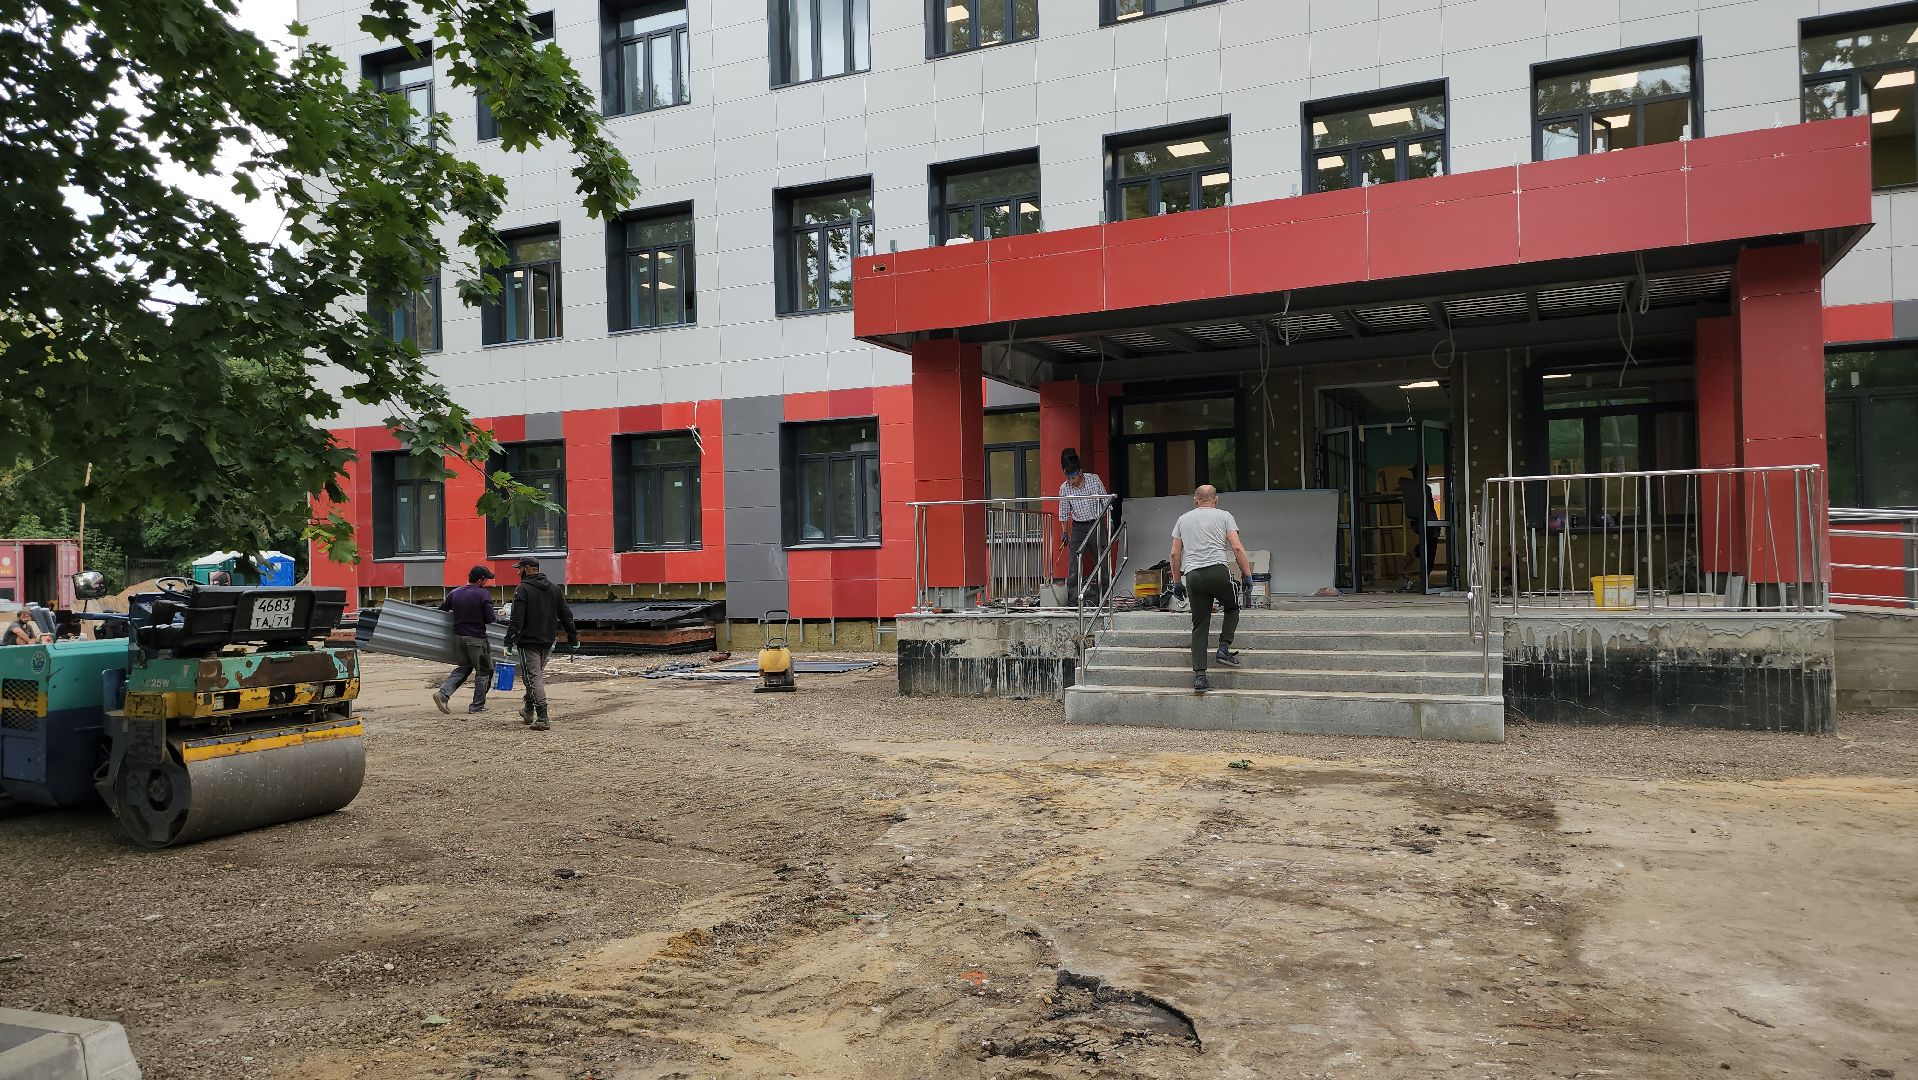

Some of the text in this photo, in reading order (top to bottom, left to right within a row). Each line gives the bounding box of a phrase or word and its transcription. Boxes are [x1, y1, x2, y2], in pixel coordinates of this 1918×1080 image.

[258, 599, 290, 612] 4683
[255, 616, 289, 627] ТА 71
